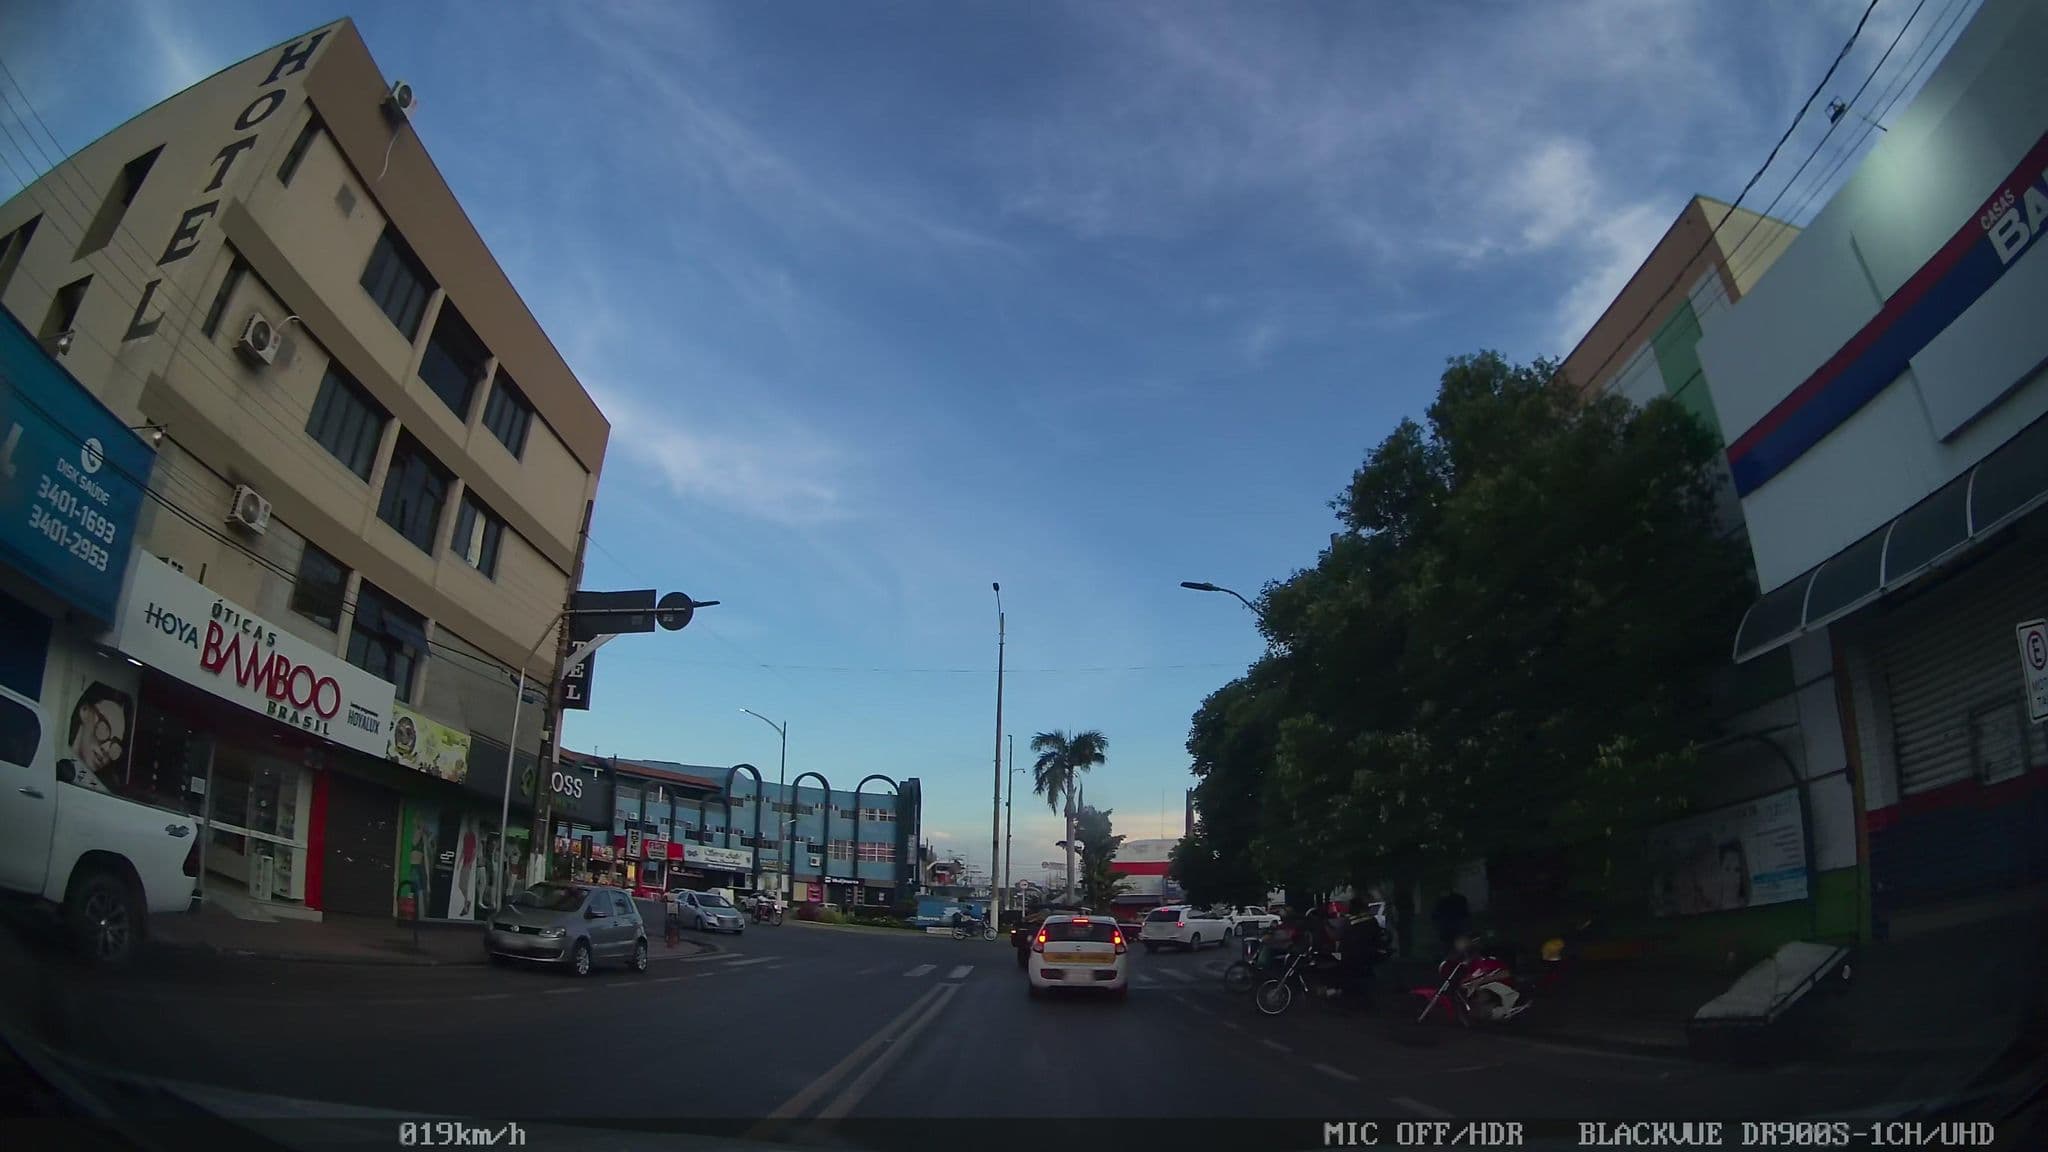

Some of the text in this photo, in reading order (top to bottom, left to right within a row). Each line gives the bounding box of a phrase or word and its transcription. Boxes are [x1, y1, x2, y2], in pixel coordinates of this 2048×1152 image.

[122, 30, 331, 342] HOTEL
[1981, 189, 2015, 230] CASAS
[1988, 168, 2048, 265] BA
[57, 457, 111, 506] DISK SAÚDE
[37, 474, 116, 544] 3401-1693
[28, 504, 109, 572] 3401-2953
[144, 602, 199, 649] HOYA
[211, 599, 277, 648] ÓTICAS
[200, 620, 341, 719] BAMBOO
[266, 700, 330, 736] BRASIL
[347, 709, 380, 735] HOYALUX
[551, 771, 583, 799] OSS
